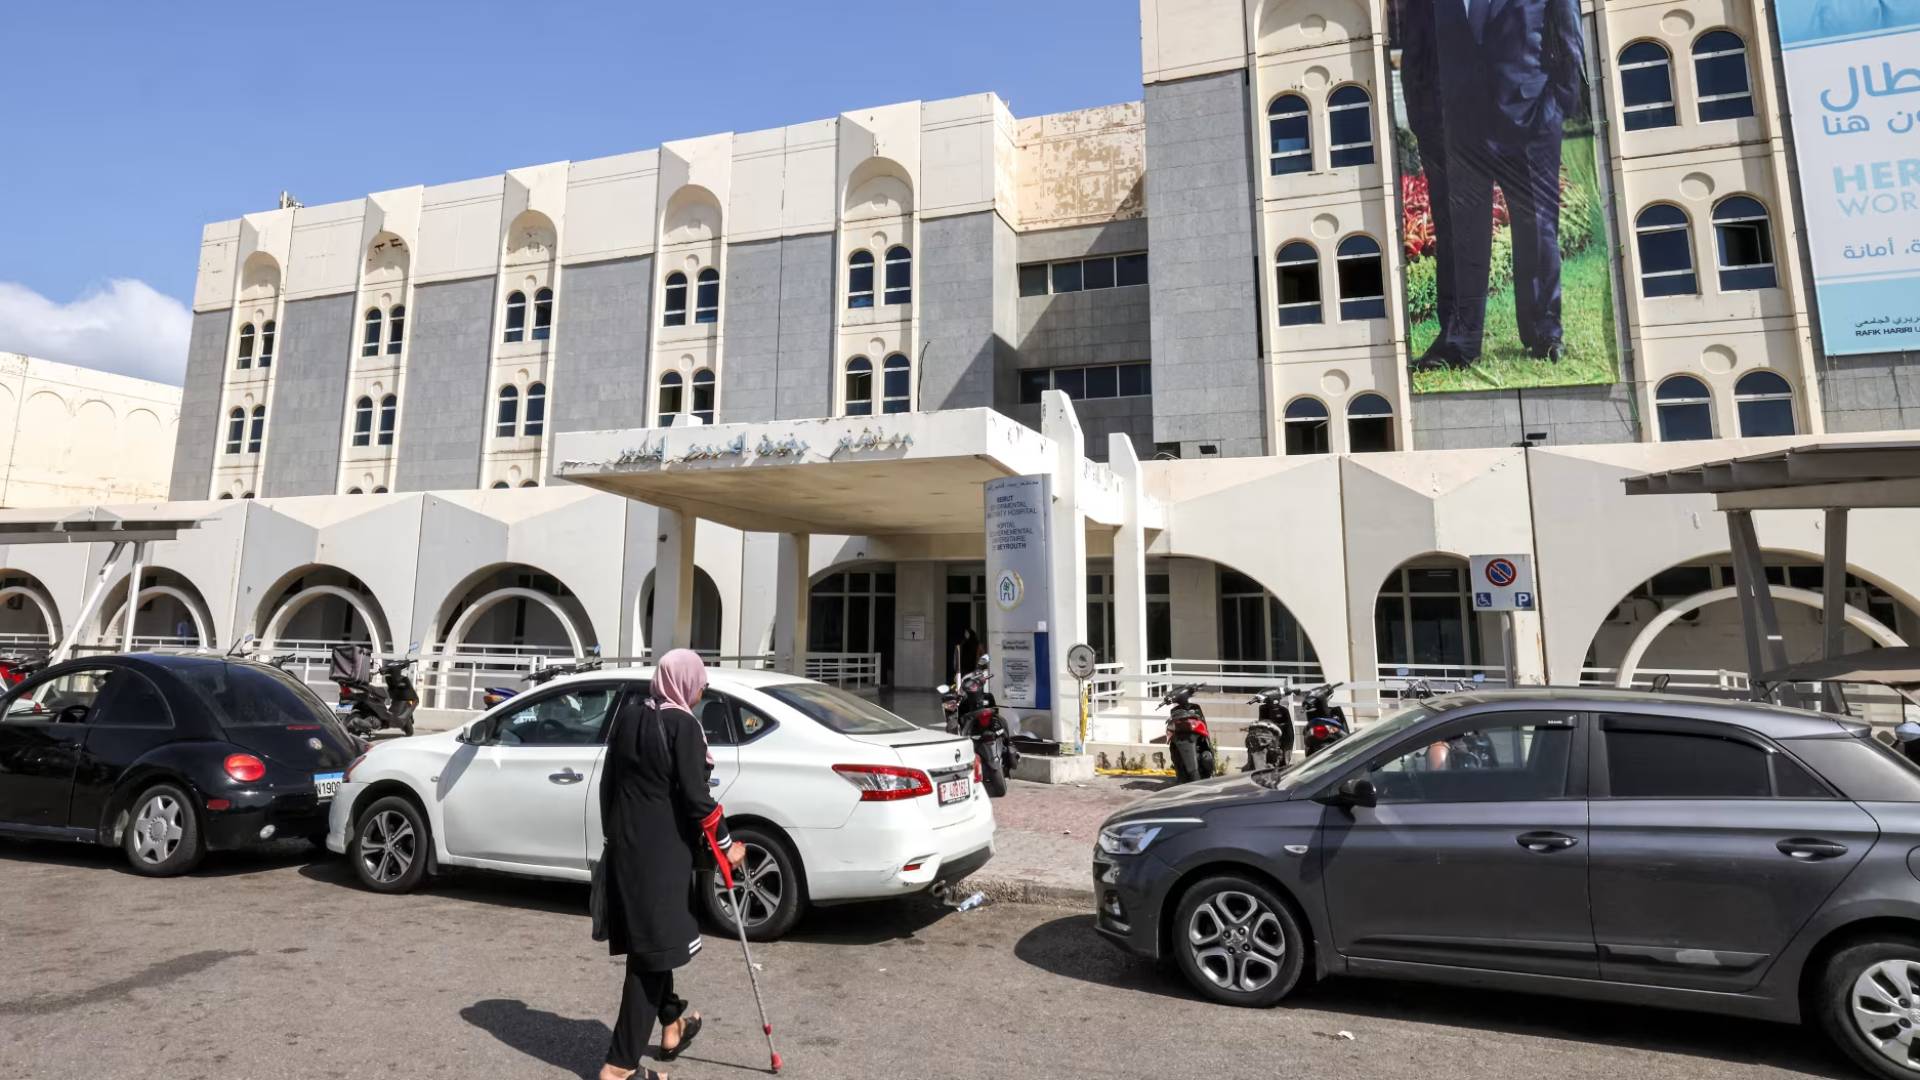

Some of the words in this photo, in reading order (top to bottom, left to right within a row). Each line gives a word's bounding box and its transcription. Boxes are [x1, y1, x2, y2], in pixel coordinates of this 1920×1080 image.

[1822, 115, 1870, 135] هنا
[1843, 237, 1894, 259] أمانة
[1518, 593, 1529, 605] P
